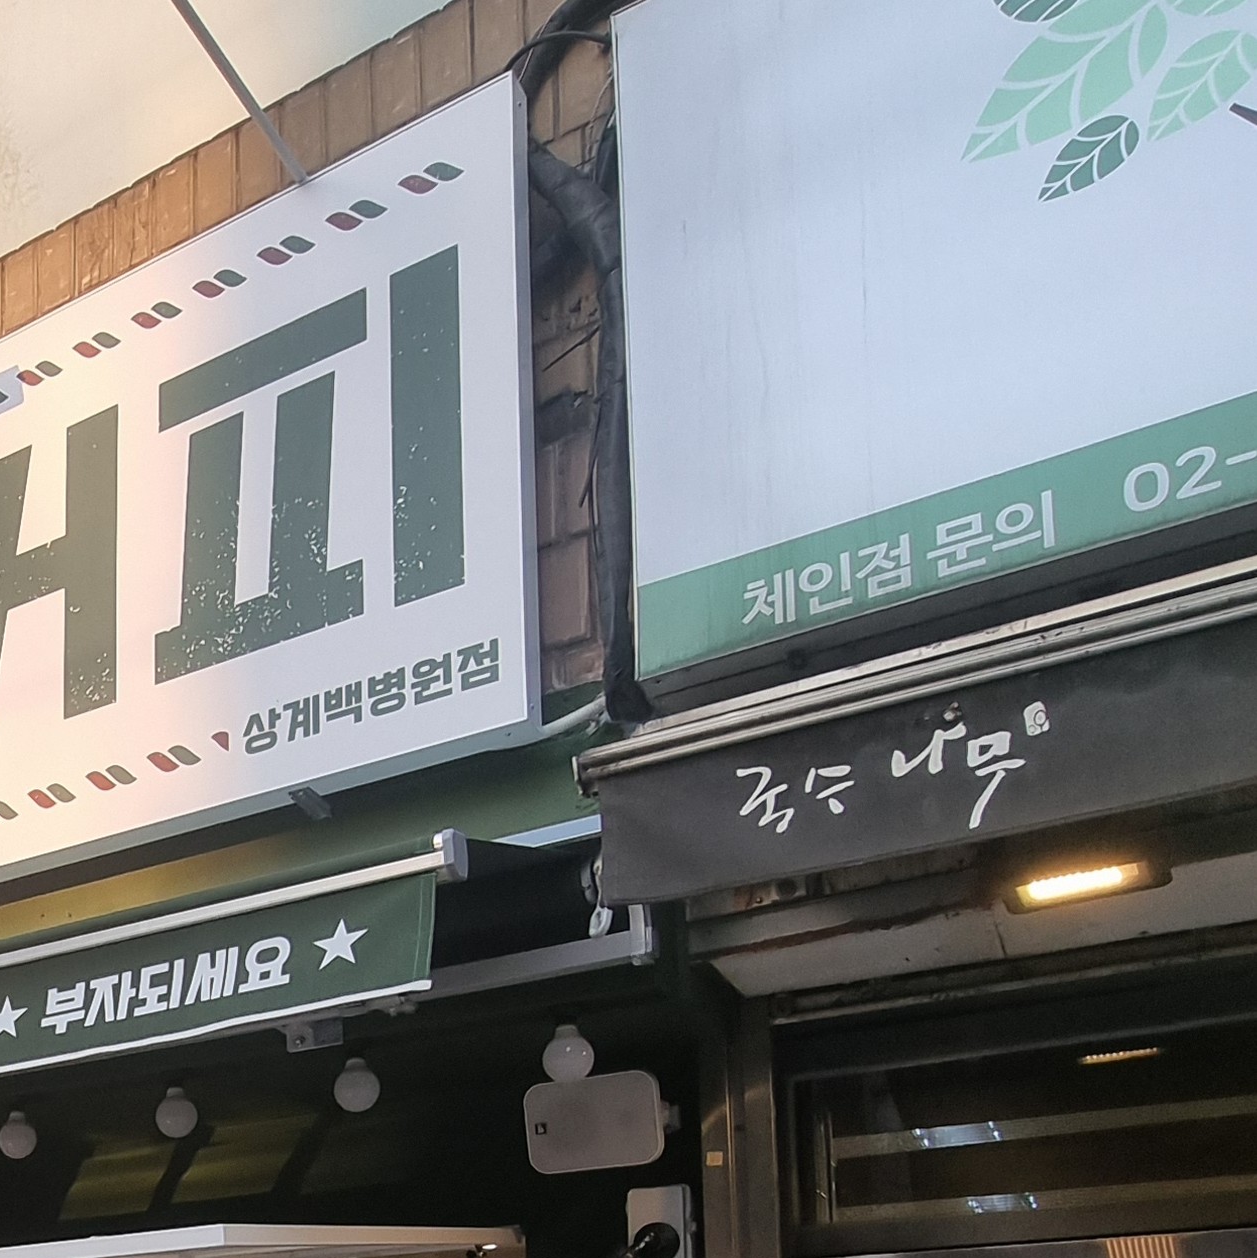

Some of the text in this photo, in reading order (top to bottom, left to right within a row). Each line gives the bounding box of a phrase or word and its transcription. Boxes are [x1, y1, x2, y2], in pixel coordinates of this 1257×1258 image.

[742, 533, 913, 627] 체인점
[926, 489, 1057, 578] 문의
[243, 637, 501, 755] 상계백병원점
[40, 936, 292, 1035] 부자되세요
